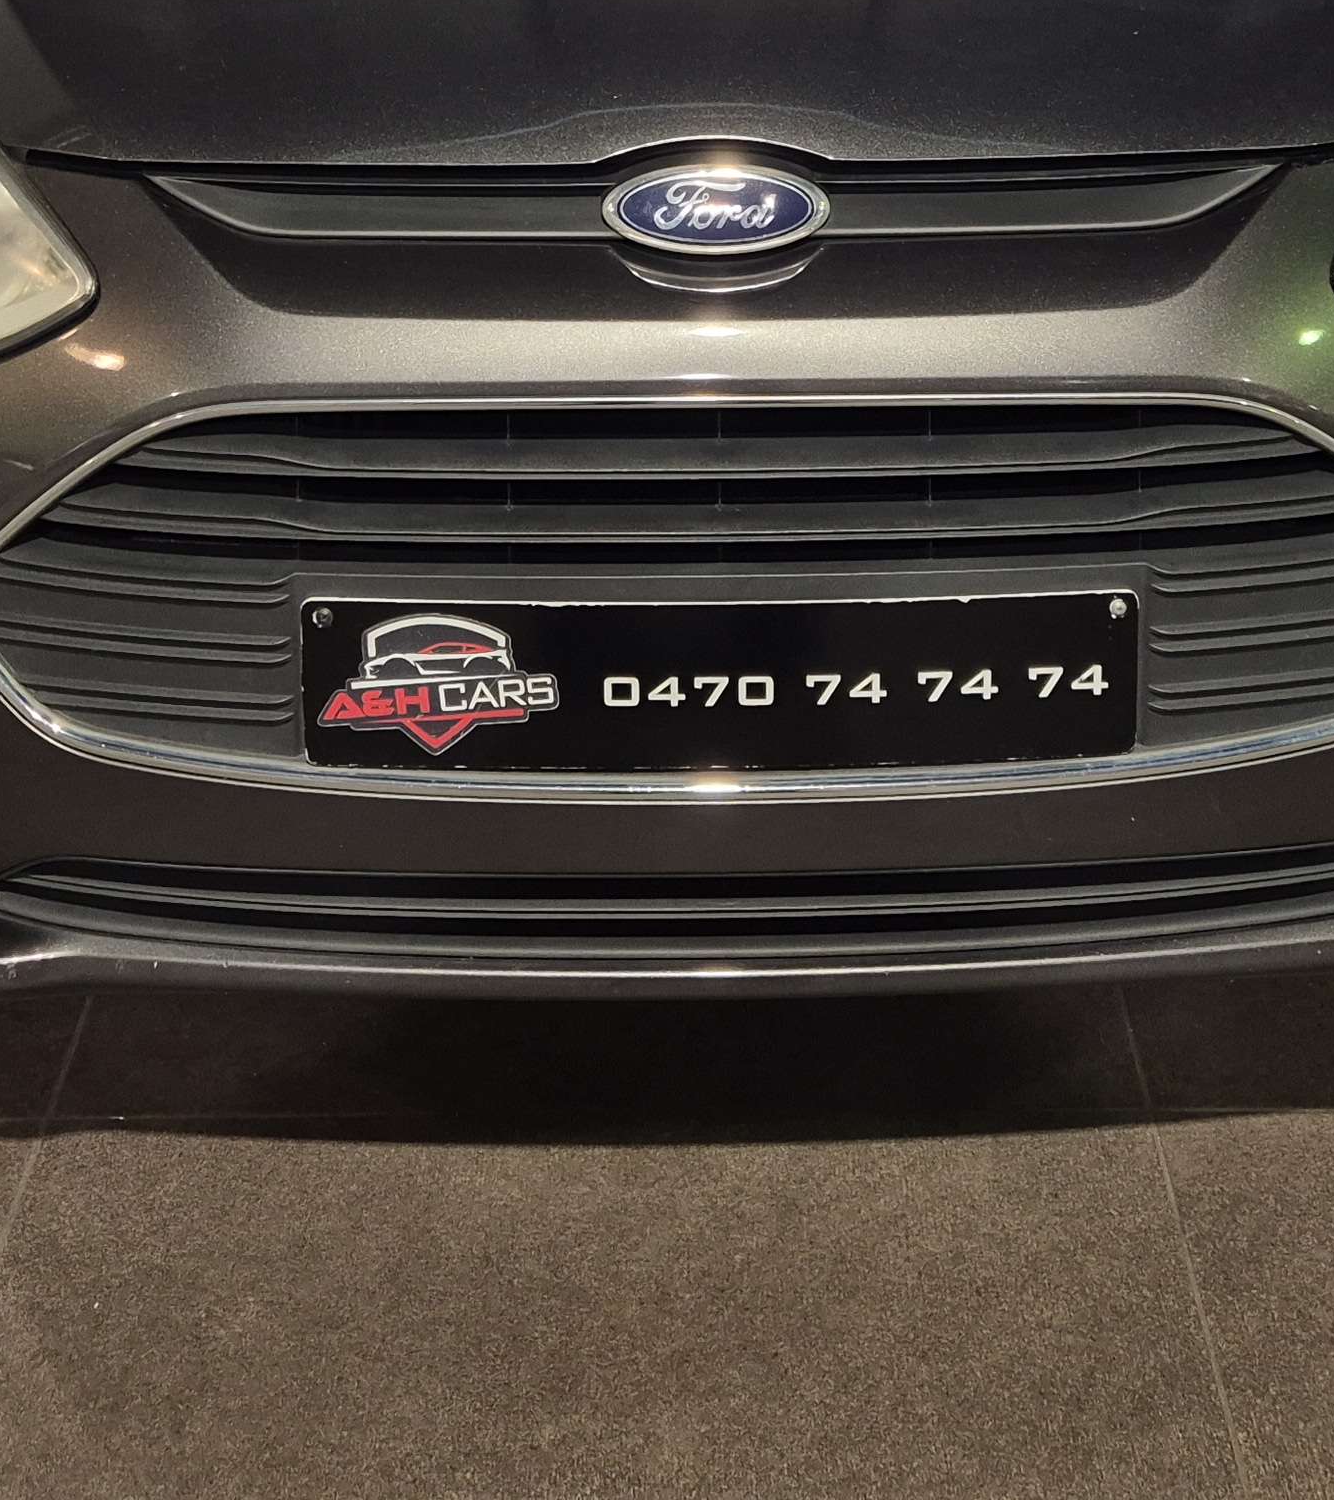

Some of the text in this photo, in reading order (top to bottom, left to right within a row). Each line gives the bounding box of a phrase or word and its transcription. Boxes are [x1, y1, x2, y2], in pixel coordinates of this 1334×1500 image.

[653, 179, 777, 231] Ford
[322, 677, 555, 720] A&H CARS
[603, 664, 1109, 708] 0470 74 74 74
